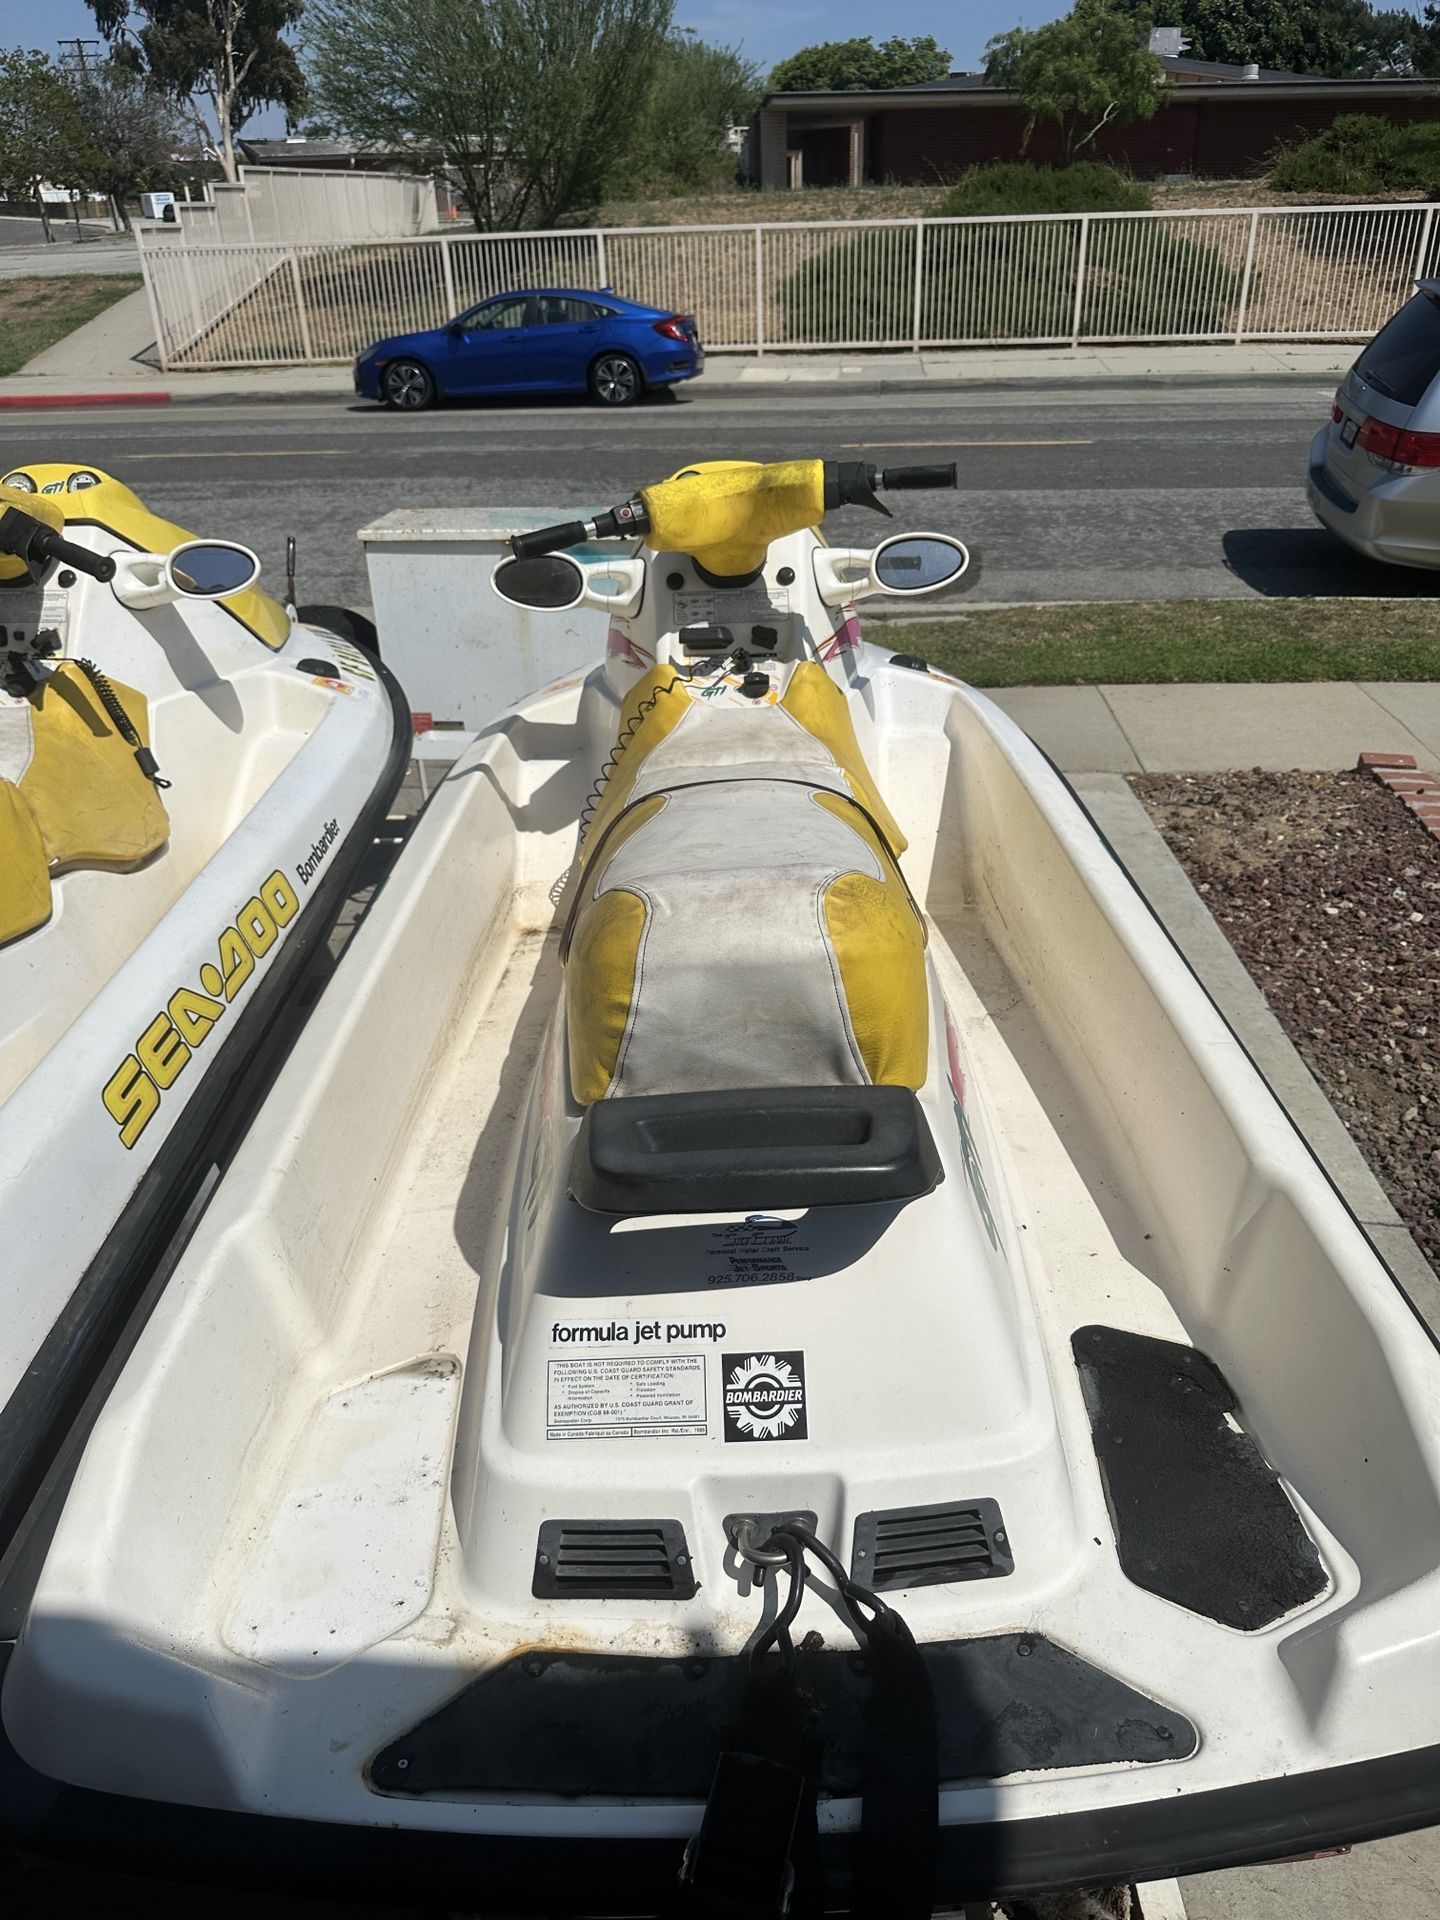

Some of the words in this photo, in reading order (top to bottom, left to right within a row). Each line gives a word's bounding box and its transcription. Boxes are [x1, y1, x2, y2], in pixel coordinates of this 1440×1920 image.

[296, 818, 341, 885] Bombardier
[707, 1272, 795, 1285] 925.706.2858
[551, 1322, 628, 1343] formula
[633, 1321, 661, 1344] jet
[666, 1322, 727, 1343] pump
[726, 1389, 802, 1404] BOMBARDIER
